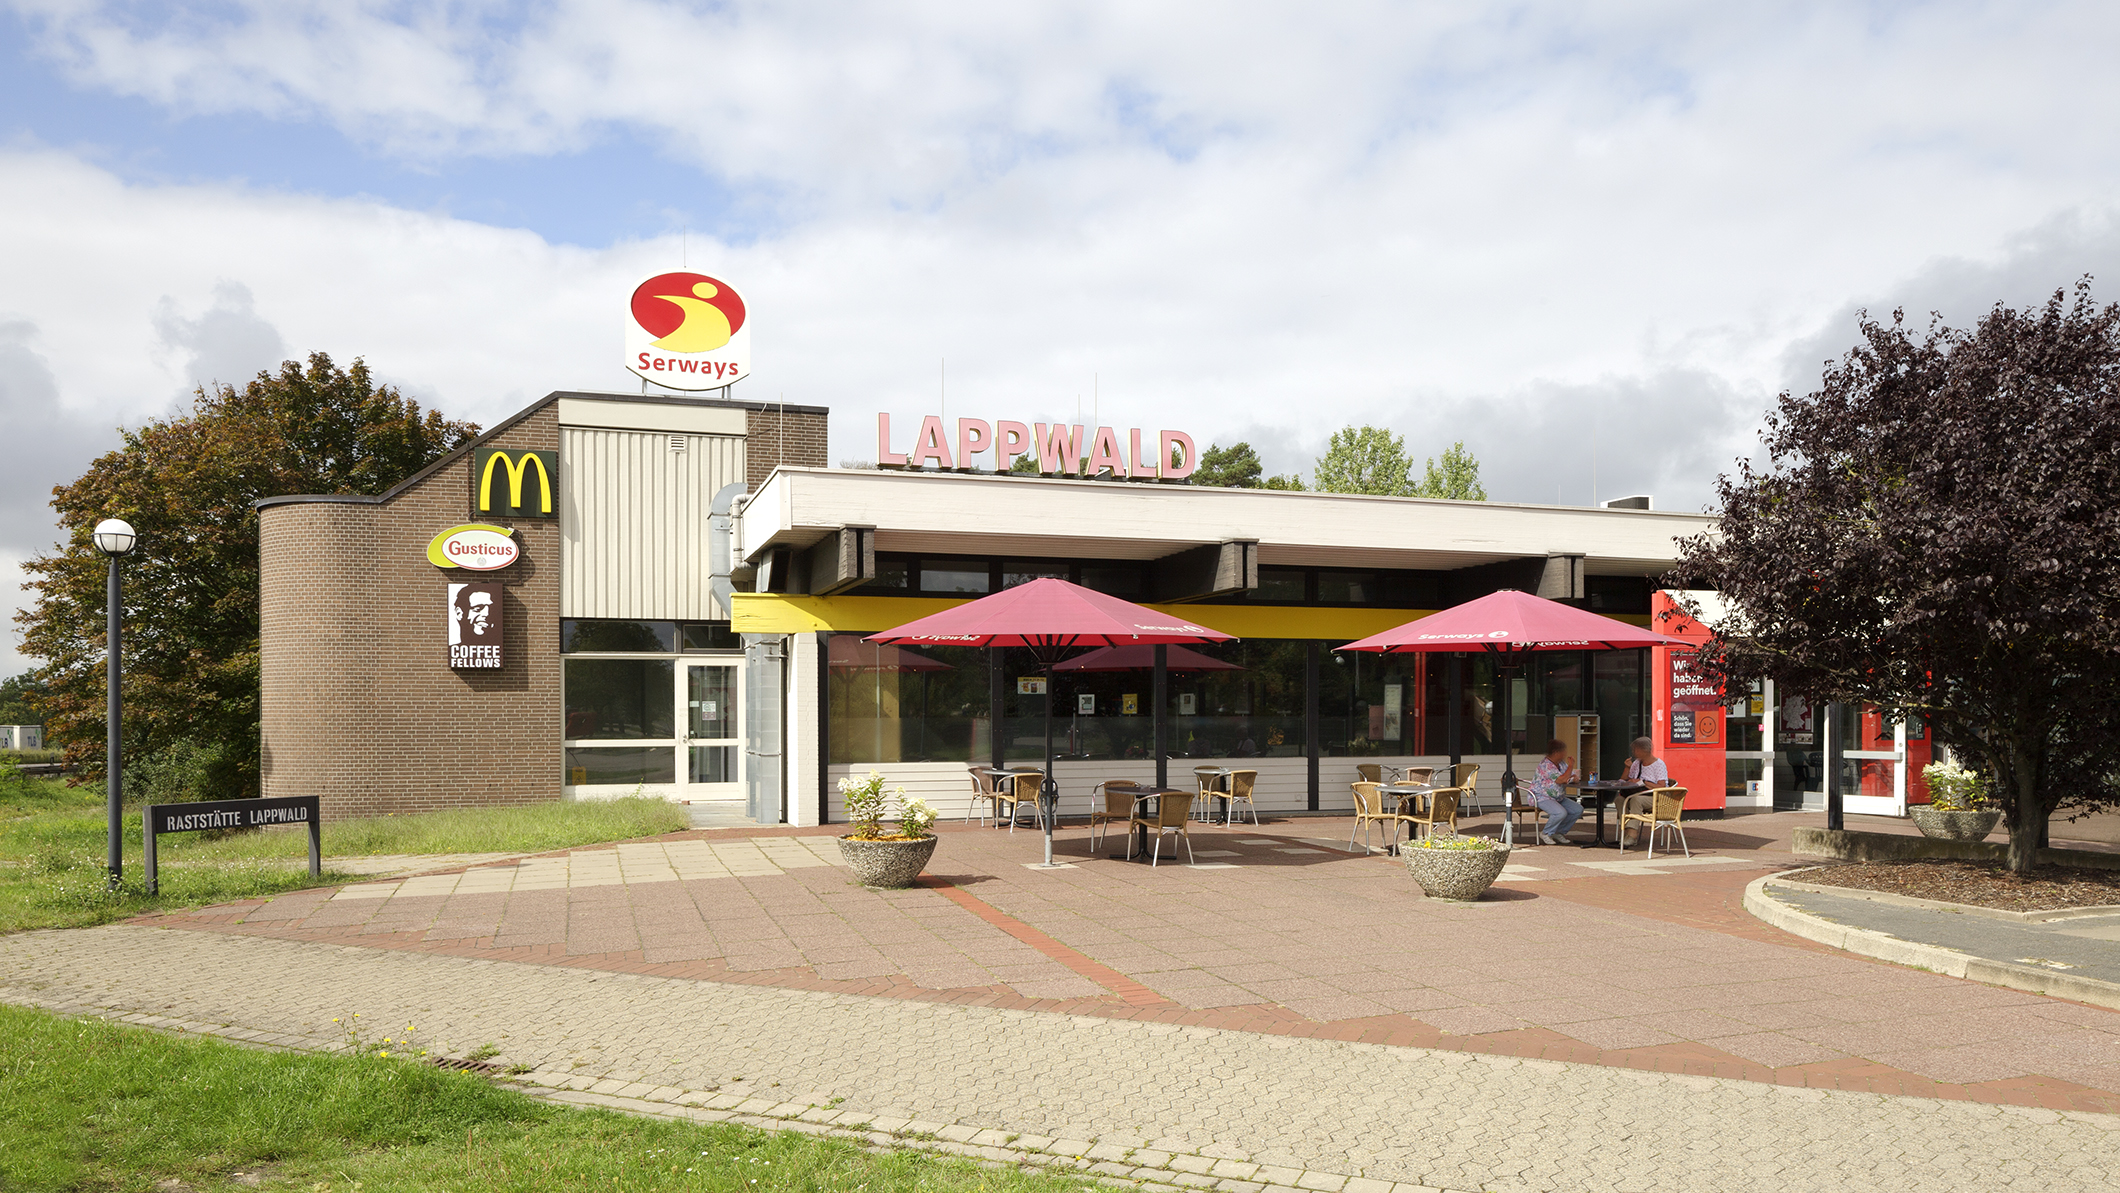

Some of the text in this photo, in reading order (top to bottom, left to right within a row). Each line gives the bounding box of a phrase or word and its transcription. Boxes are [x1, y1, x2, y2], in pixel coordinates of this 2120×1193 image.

[638, 352, 739, 380] Serways
[877, 412, 1196, 480] LAPPWALD
[448, 540, 513, 556] Gusticus
[450, 645, 500, 659] COFFEE
[450, 658, 501, 668] FELLOWS
[1673, 660, 1691, 671] Wi
[1673, 684, 1717, 698] geöffnet.
[167, 807, 307, 831] RASTSTÄTTE LAPPWALD
